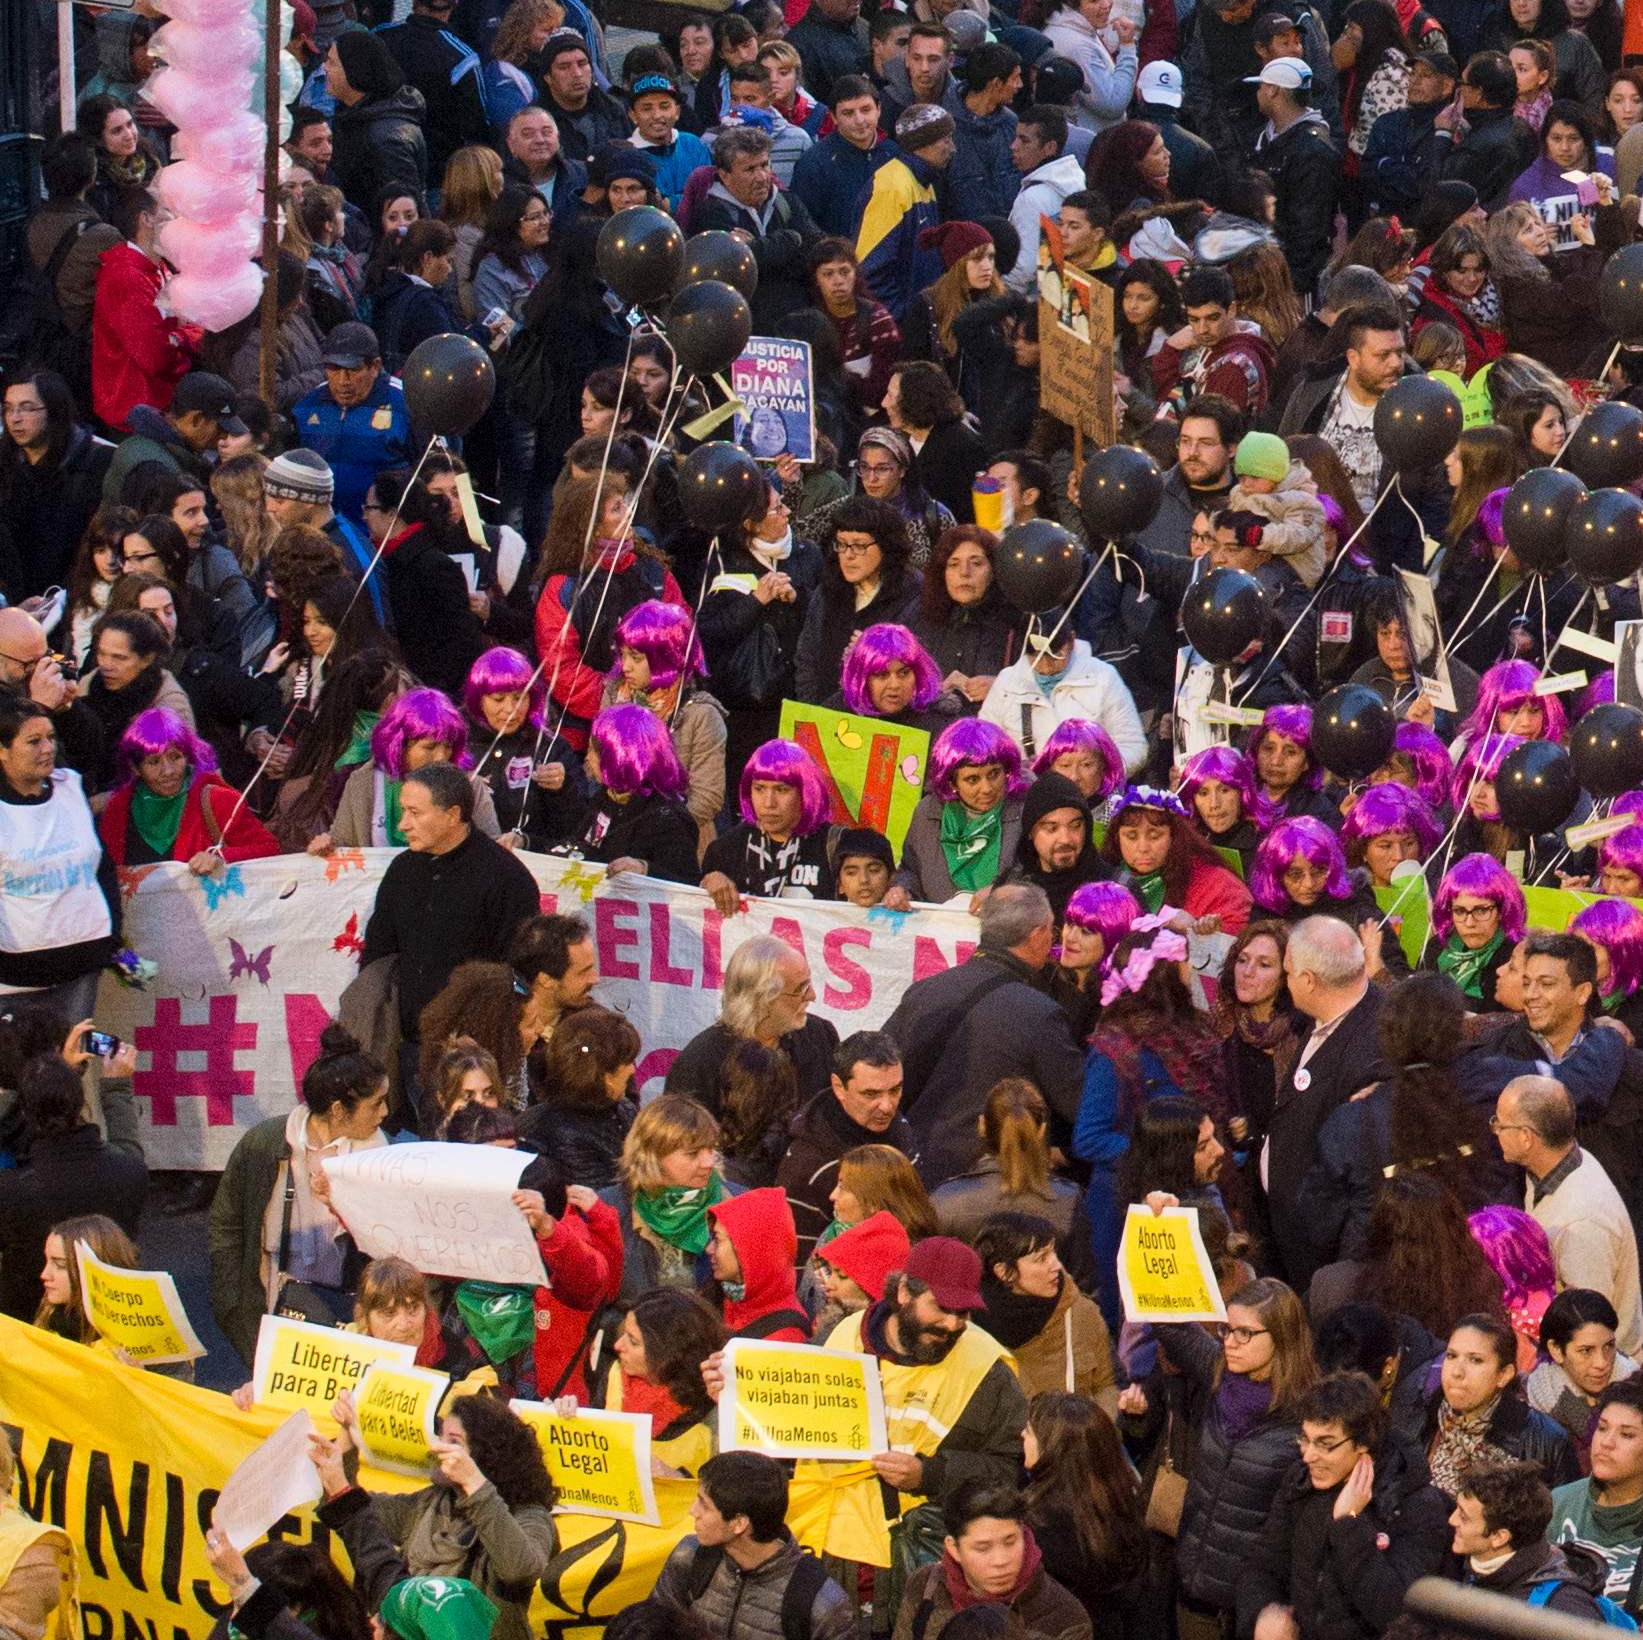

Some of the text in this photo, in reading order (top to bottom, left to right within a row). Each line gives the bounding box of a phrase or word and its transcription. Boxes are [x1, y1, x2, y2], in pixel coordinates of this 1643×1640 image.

[756, 359, 789, 376] POR
[736, 374, 806, 399] DIANA
[413, 1195, 478, 1232] NOS
[370, 1223, 534, 1276] QUEREMOS
[1137, 1225, 1177, 1251] Aborto
[1143, 1251, 1180, 1280] Legal
[269, 1369, 318, 1398] para
[735, 1364, 754, 1381] No
[758, 1366, 821, 1387] viajaban
[366, 1376, 420, 1414] Libertad
[747, 1389, 859, 1410] viajaban juntas
[388, 1415, 425, 1446] Belén
[549, 1422, 611, 1453] Aborto
[558, 1447, 610, 1475] Legal
